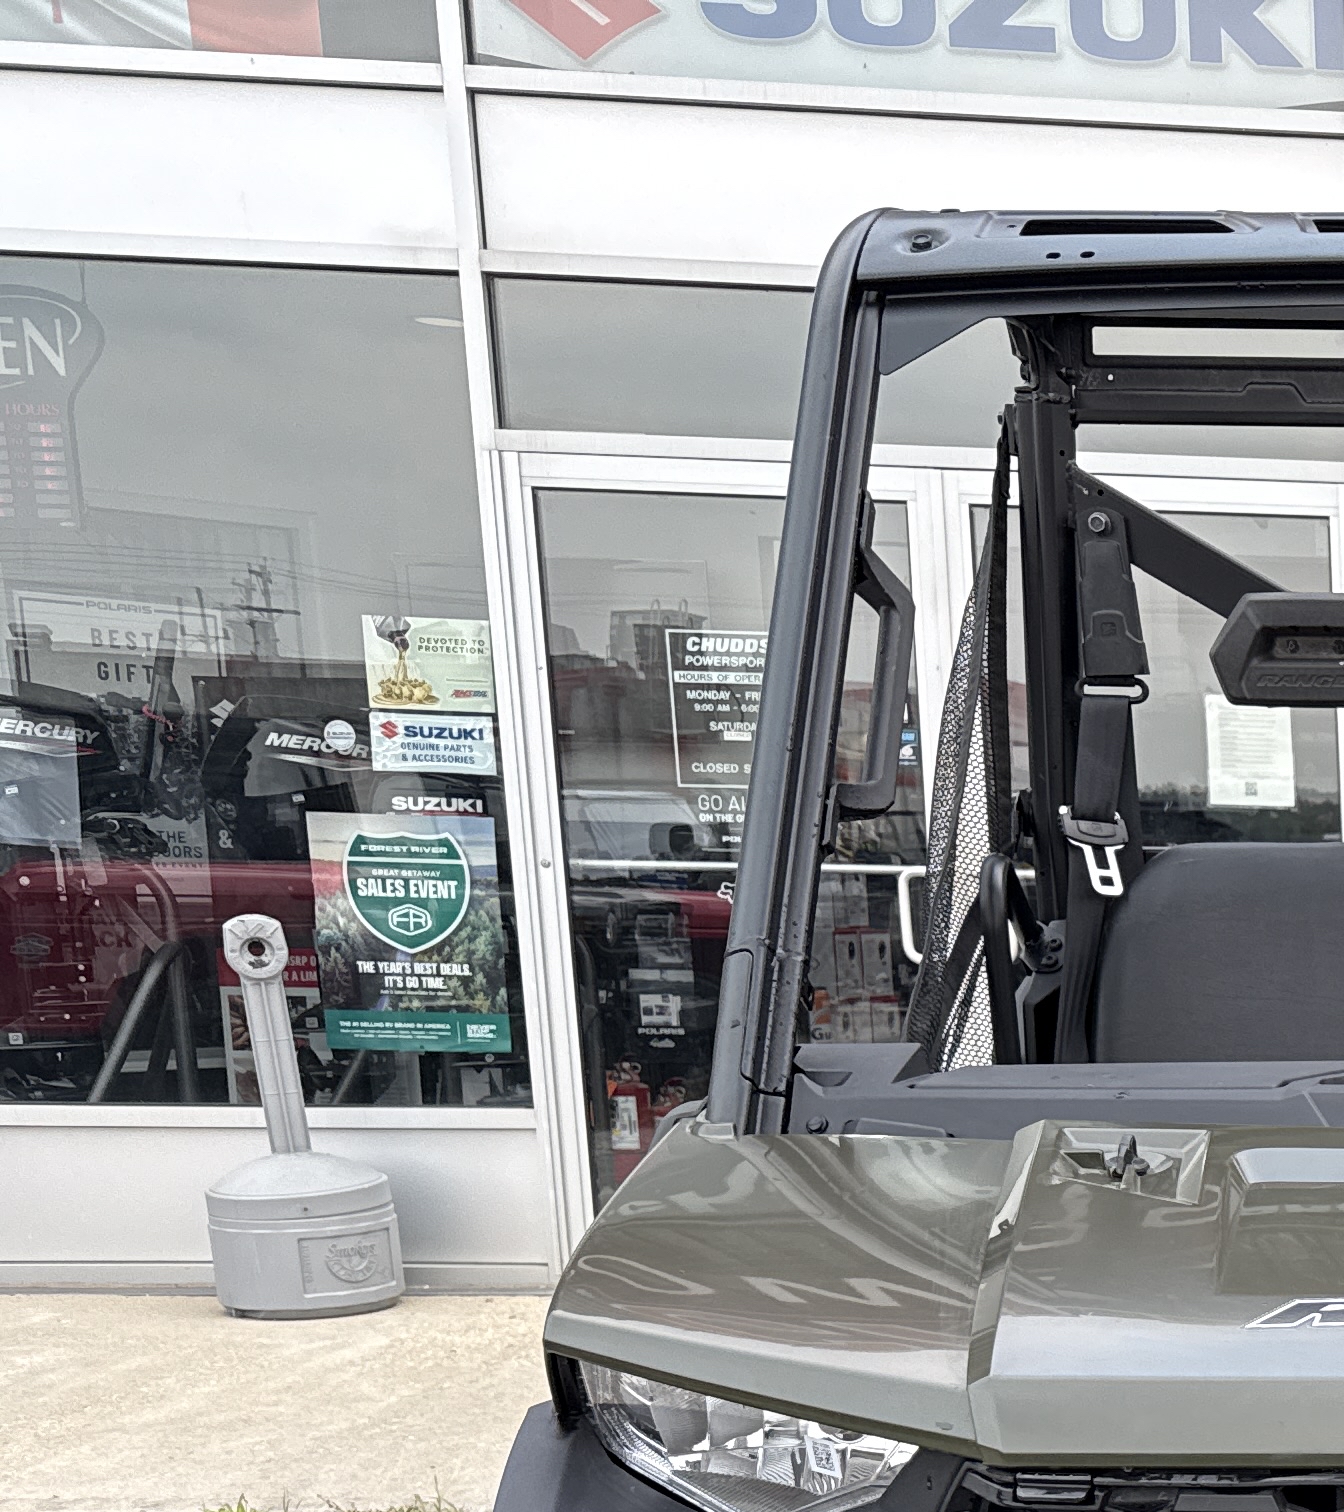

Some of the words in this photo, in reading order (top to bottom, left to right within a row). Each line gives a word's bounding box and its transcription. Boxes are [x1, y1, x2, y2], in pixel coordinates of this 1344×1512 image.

[5, 403, 60, 416] HOURS
[85, 600, 153, 614] POLARIS
[418, 636, 468, 646] DEVOTED
[471, 638, 486, 647] TO
[686, 636, 768, 654] CHUDDS
[678, 672, 713, 682] HOURS
[716, 673, 732, 683] OF
[686, 690, 731, 700] MONDAY
[0, 718, 100, 745] ERCURY
[403, 725, 484, 741] SUZUKI
[400, 742, 442, 752] GENUINE
[443, 744, 474, 753] PARTS
[401, 754, 408, 762] &
[411, 754, 475, 765] ACCESSORIES
[691, 762, 739, 774] CLOSED
[391, 796, 483, 813] SUZUKI
[697, 794, 722, 811] GO
[699, 812, 714, 823] ON
[715, 813, 735, 823] THE
[218, 829, 234, 849] &
[360, 844, 409, 853] FOREST
[411, 846, 448, 854] RIVER
[371, 868, 399, 876] GREAT
[400, 869, 441, 877] GETAWAY
[356, 877, 406, 898] SALES
[409, 879, 458, 900] EVENT
[356, 960, 375, 974] THE
[377, 961, 412, 975] YEAR'S
[413, 962, 438, 975] BEST
[384, 975, 404, 988] IT'S
[405, 976, 420, 988] GO
[637, 1027, 686, 1036] POLARIS
